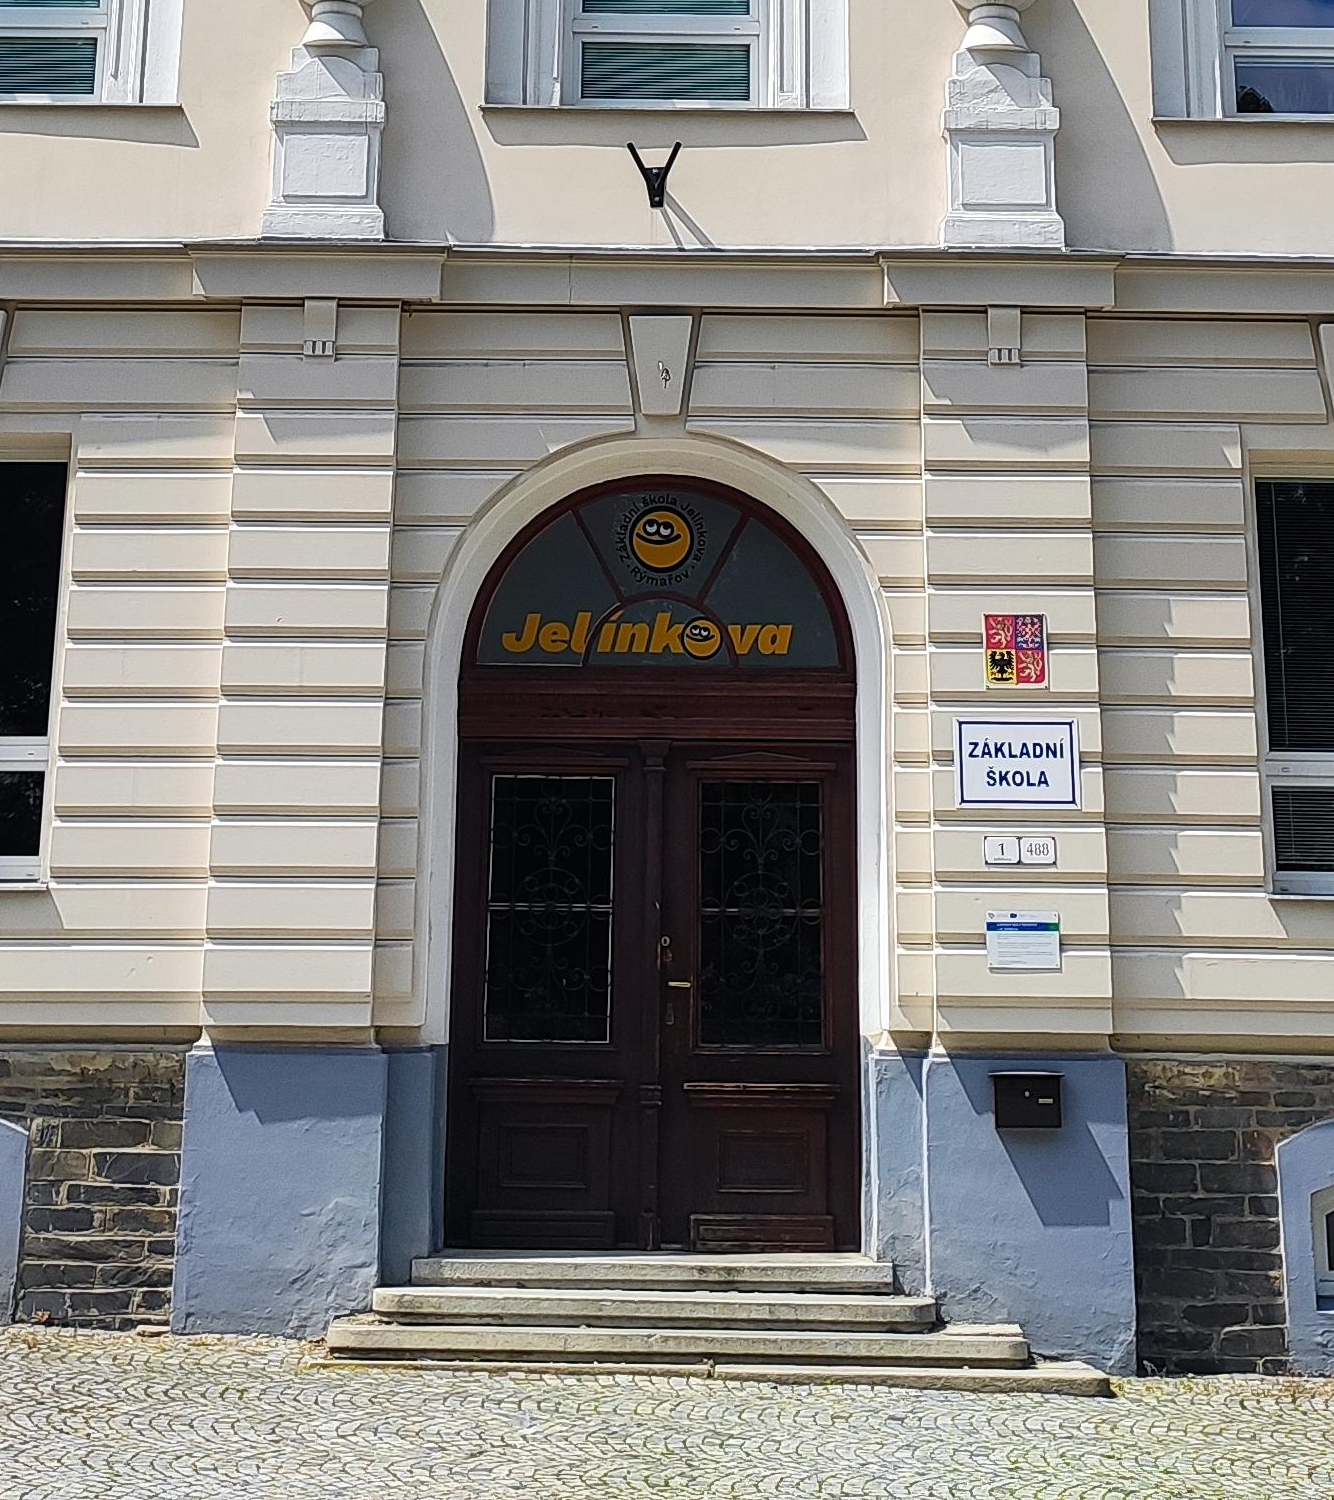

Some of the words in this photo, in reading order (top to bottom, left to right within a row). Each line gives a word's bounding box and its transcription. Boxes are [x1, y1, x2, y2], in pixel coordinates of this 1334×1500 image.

[616, 501, 640, 563] Základní
[641, 493, 677, 508] škola
[630, 566, 689, 587] Rýmařov
[968, 737, 1065, 759] ZÁKLADNÍ
[986, 765, 1050, 788] ŠKOLA
[998, 842, 1005, 856] 1
[1026, 842, 1050, 856] 488
